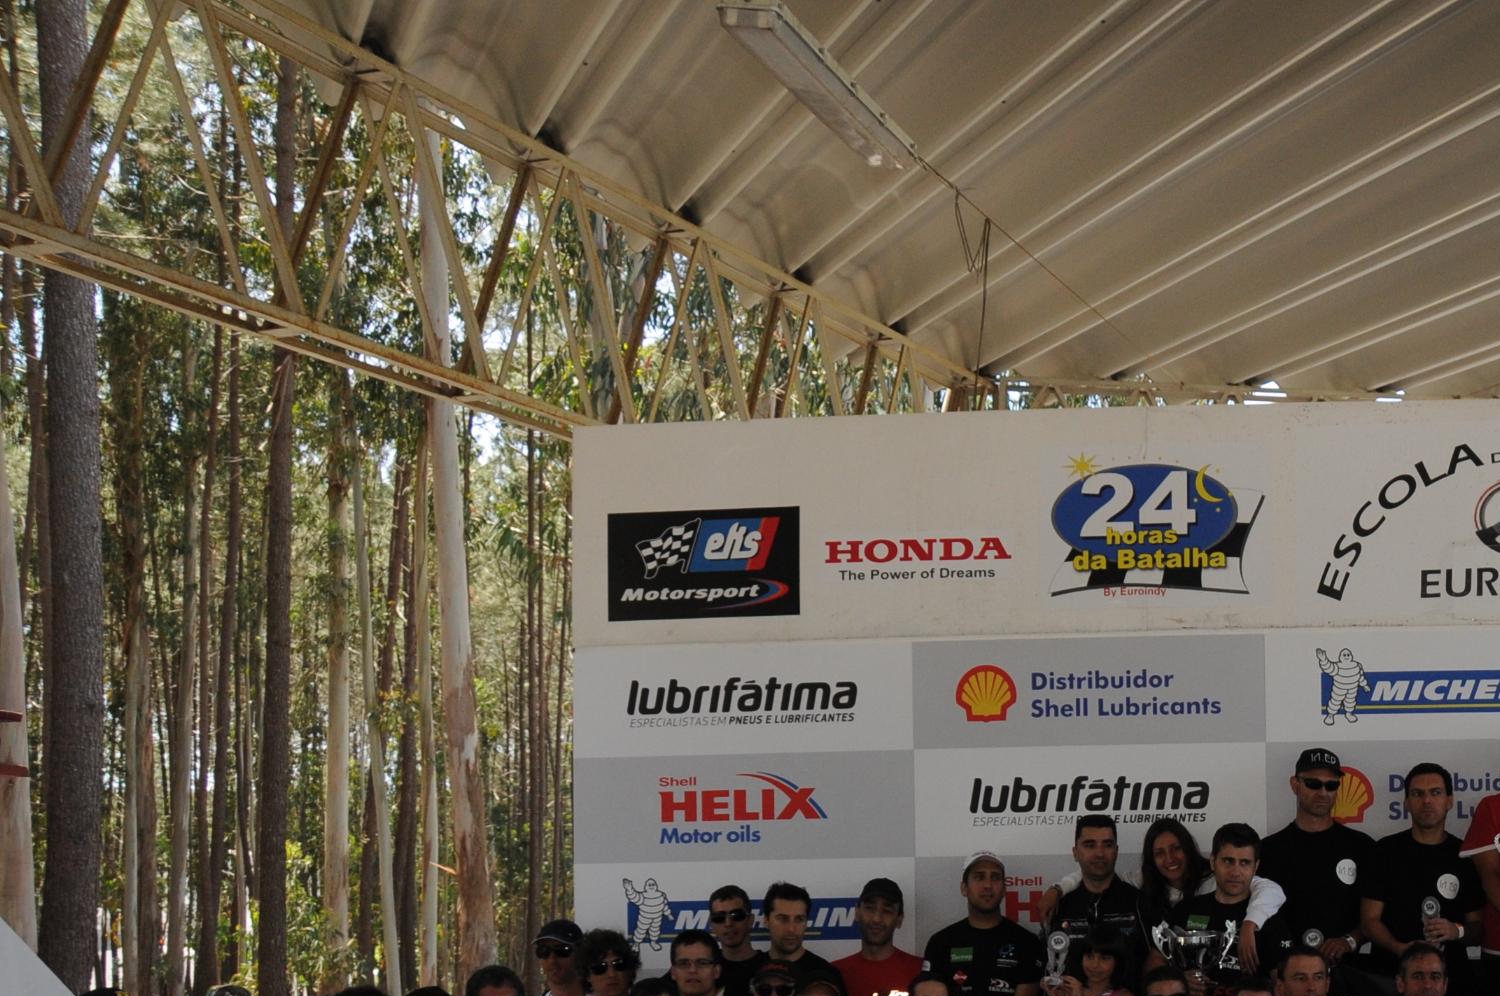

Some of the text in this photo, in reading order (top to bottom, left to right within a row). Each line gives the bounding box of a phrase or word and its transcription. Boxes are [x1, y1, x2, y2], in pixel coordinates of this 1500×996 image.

[1079, 470, 1197, 538] 24
[1316, 442, 1484, 602] ESCOLA
[1106, 527, 1179, 545] horas
[825, 537, 1012, 564] HONDA
[1072, 548, 1227, 571] da Batalha
[839, 566, 996, 581] The Power of Dreams
[620, 584, 761, 602] Motorsport
[1103, 585, 1167, 598] By Euroindy
[1030, 669, 1174, 690] Distribuidor
[626, 676, 858, 716] lubrifátima
[1030, 697, 1222, 718] Shell Lubricants
[629, 712, 855, 728] ESPECIALISTAS EM PNEUS E LUBRIFICANTES
[658, 776, 697, 787] Shell
[658, 787, 822, 822] HELIX
[969, 776, 1210, 813] lubrifátima
[972, 815, 1055, 827] ESPECIALISTAS
[1056, 815, 1074, 825] EM
[659, 825, 761, 845] Motor oils
[1004, 876, 1043, 887] Shell
